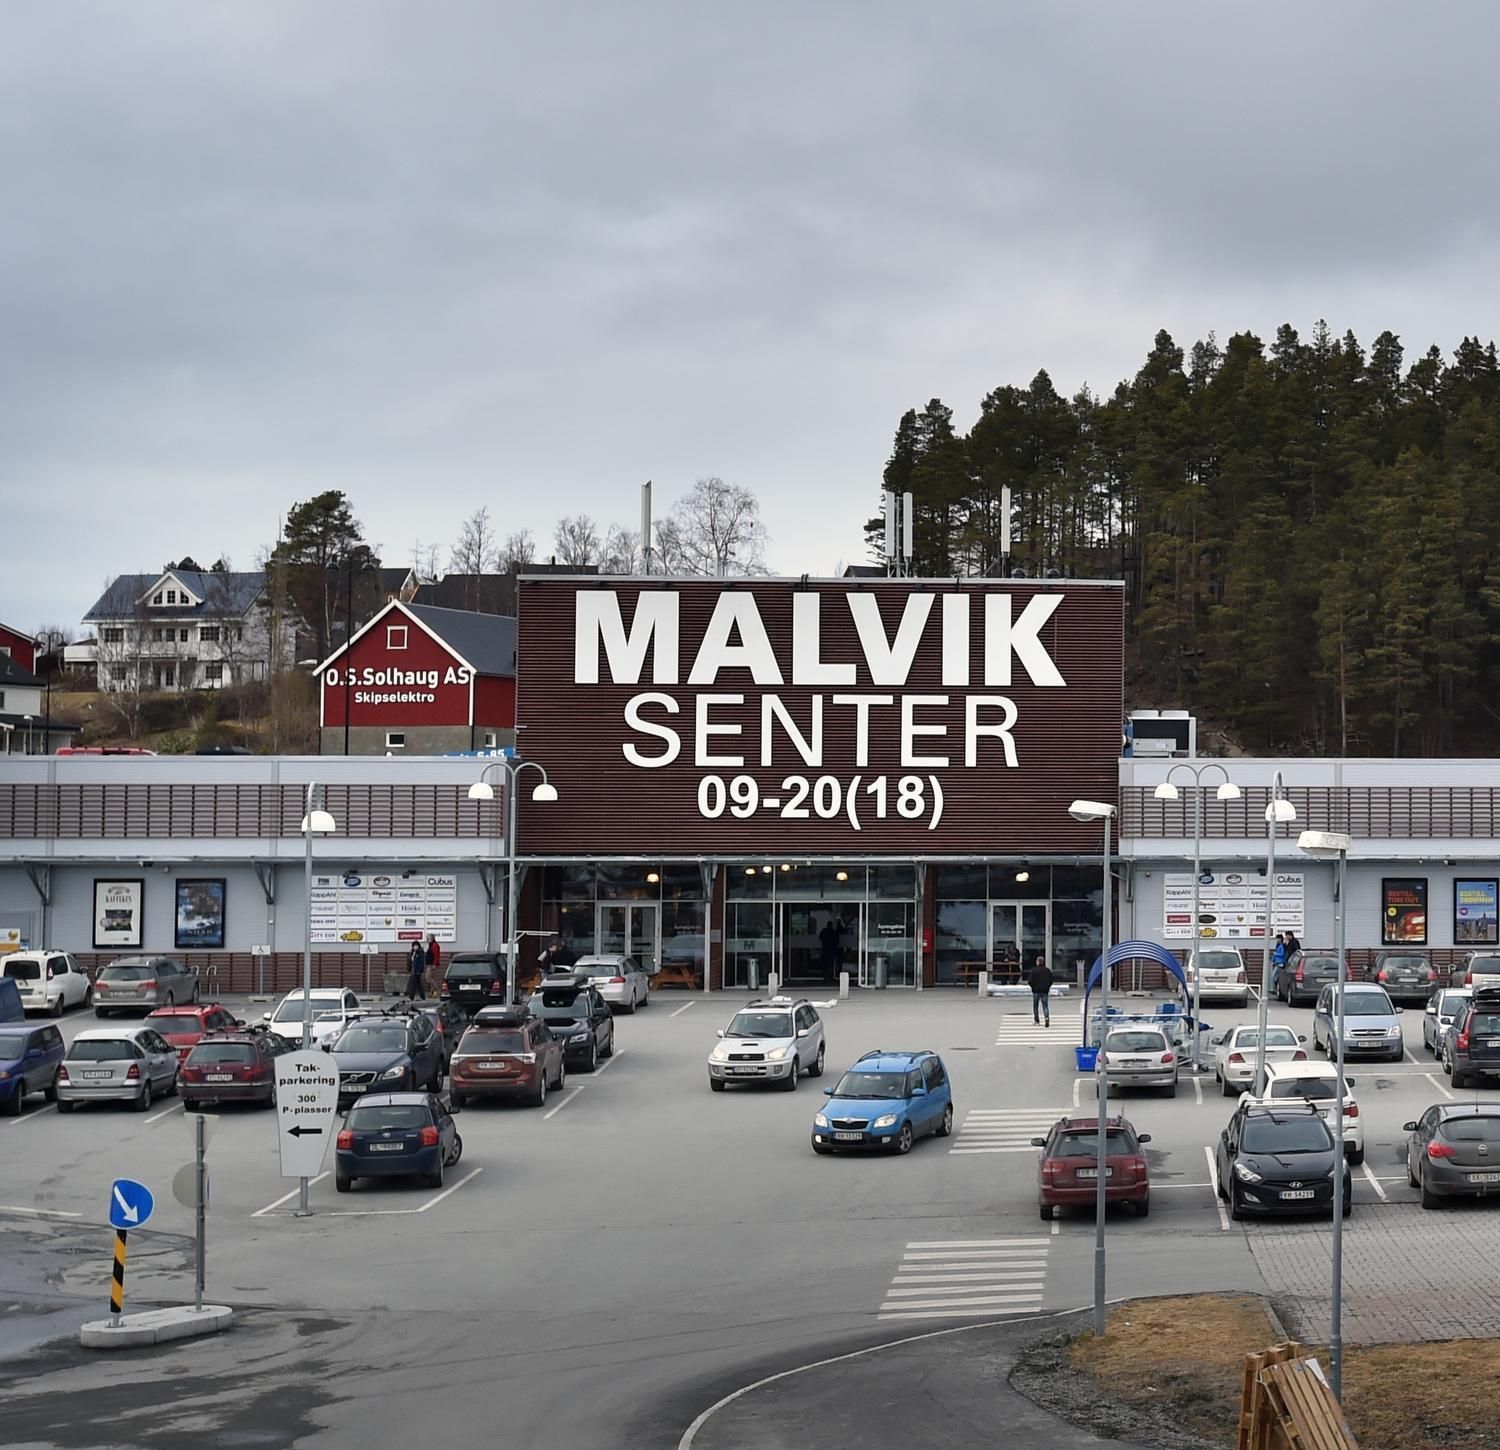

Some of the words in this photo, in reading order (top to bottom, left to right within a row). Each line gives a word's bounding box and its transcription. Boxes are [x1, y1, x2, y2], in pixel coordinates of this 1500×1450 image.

[574, 590, 1067, 686] MALVIK
[443, 666, 470, 685] AS
[354, 691, 435, 705] Skipselektro
[622, 692, 1019, 768] SENTER
[697, 775, 944, 830] 09-20(18)
[427, 877, 453, 886] Cubus
[1277, 875, 1301, 884] Cubus
[295, 1063, 320, 1072] Tak-
[279, 1075, 335, 1087] parkering
[297, 1095, 316, 1103] 300
[282, 1106, 332, 1115] P-plasser
